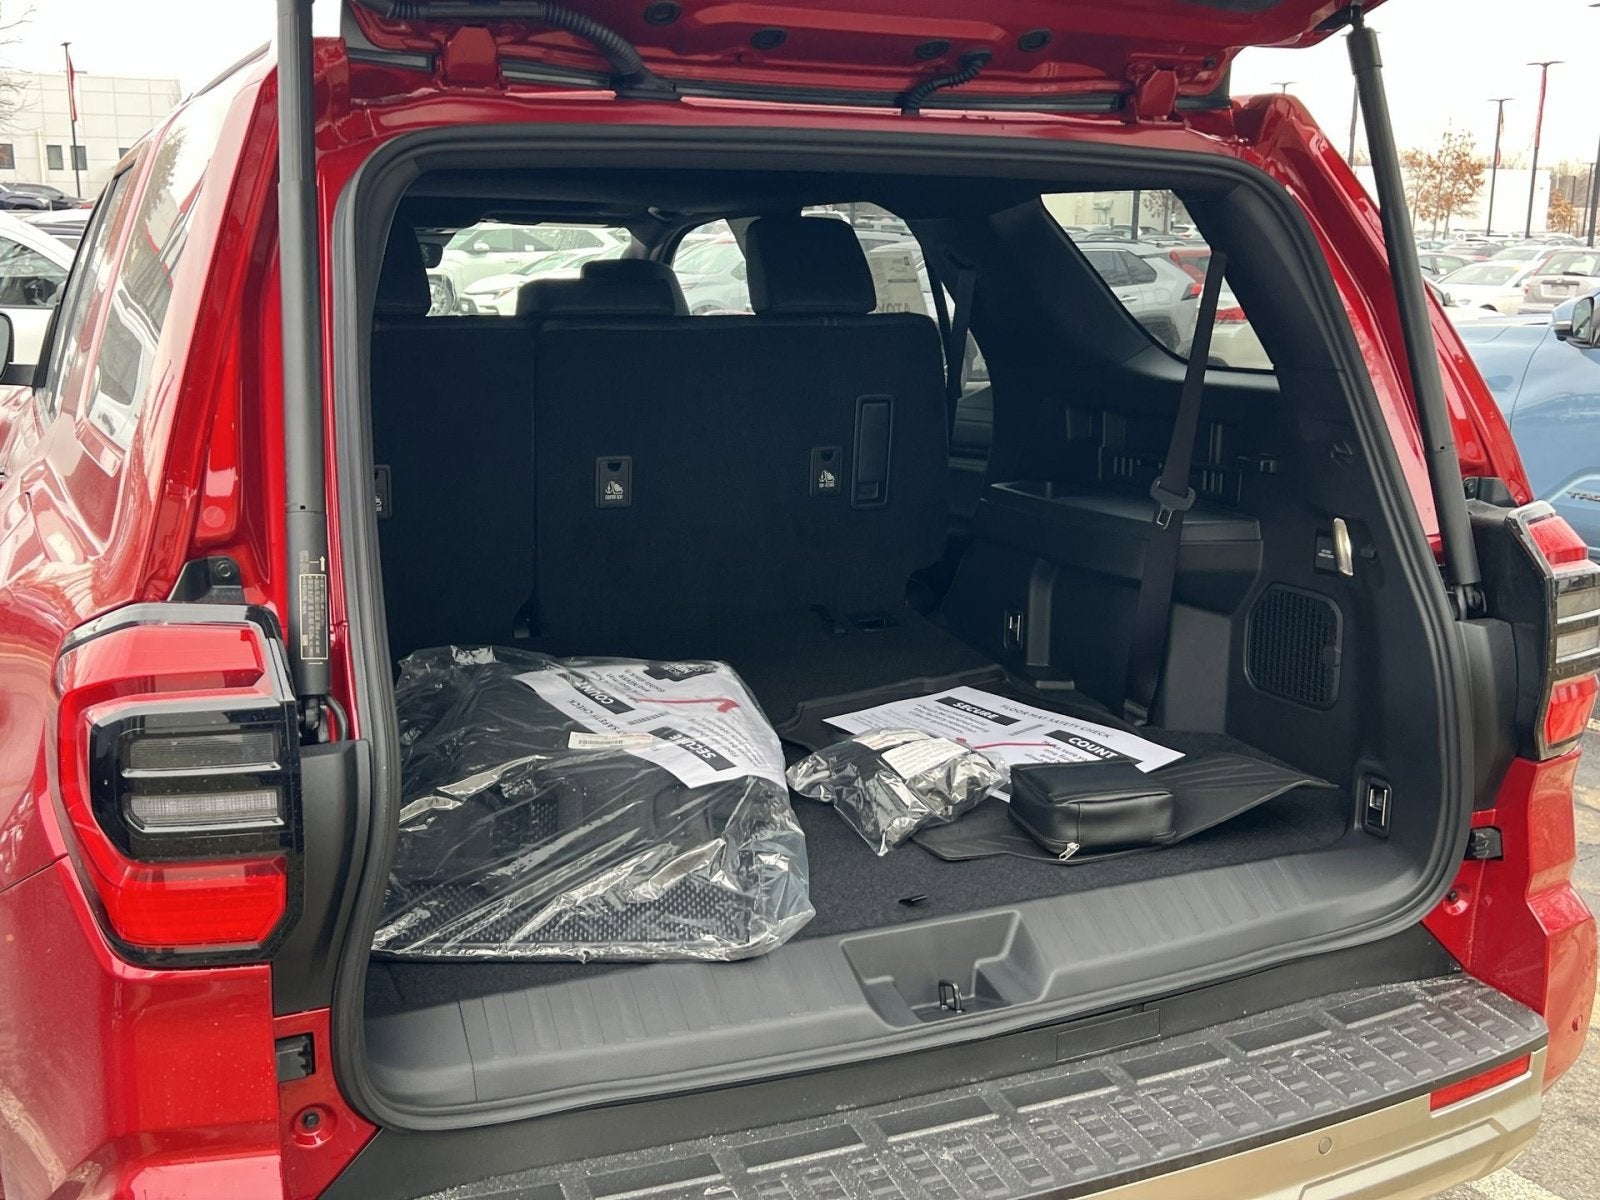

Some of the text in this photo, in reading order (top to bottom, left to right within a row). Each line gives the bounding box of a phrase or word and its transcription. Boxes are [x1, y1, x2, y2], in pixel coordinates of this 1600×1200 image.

[575, 681, 614, 704] COUNT
[569, 699, 594, 713] CHECK
[952, 702, 1000, 720] SECURE
[590, 713, 621, 731] SAFETY
[1001, 704, 1029, 716] FLOOR
[1050, 718, 1079, 729] SAFETY
[1081, 727, 1112, 739] CHECK
[669, 733, 717, 758] SECURE
[1068, 737, 1118, 759] COUNT
